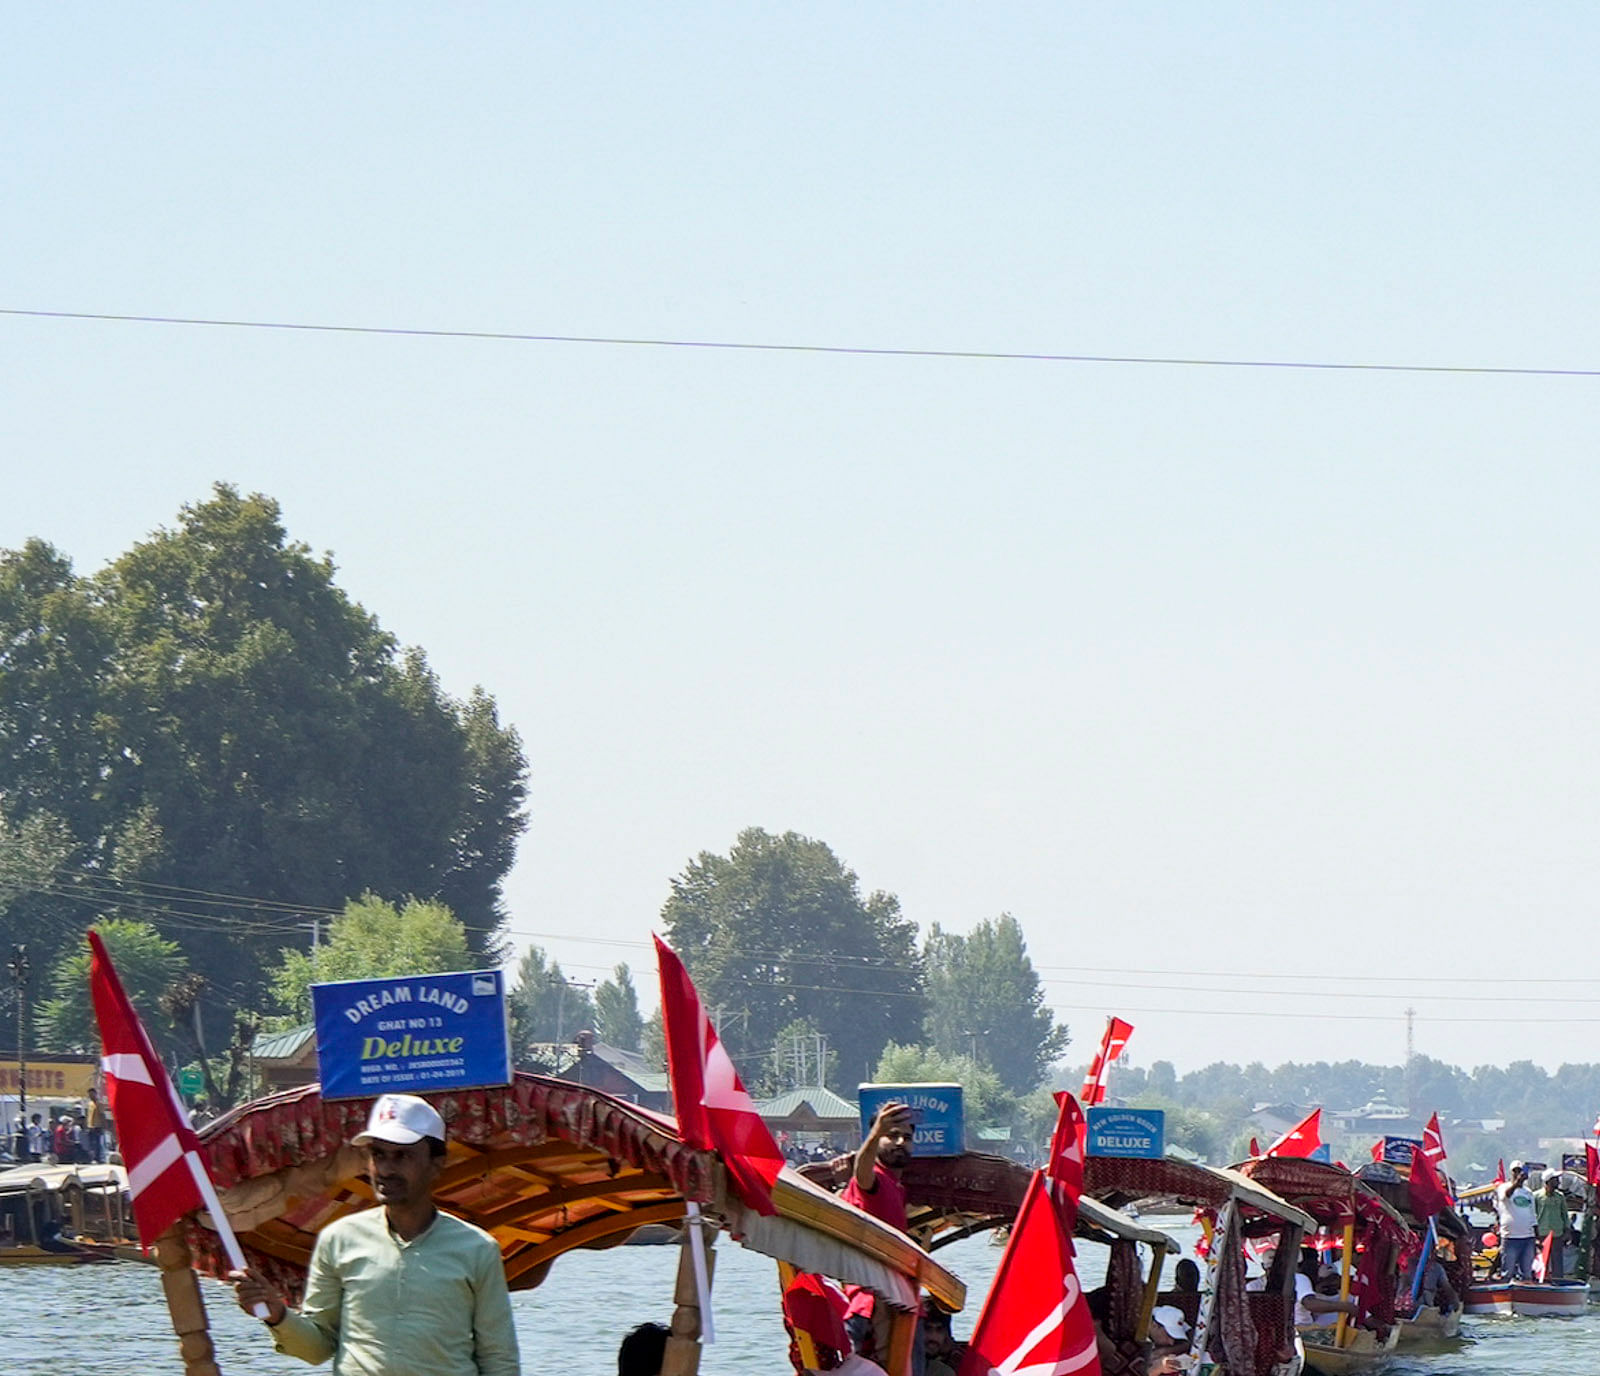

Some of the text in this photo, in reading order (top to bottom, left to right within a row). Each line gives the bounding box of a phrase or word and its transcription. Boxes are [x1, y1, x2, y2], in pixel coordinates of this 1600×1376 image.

[344, 986, 470, 1024] DREAM LAND
[377, 1017, 443, 1032] GHAT NO 13
[360, 1034, 464, 1060] Deluxe
[913, 1095, 949, 1113] JHON
[1097, 1136, 1152, 1149] DELUXE
